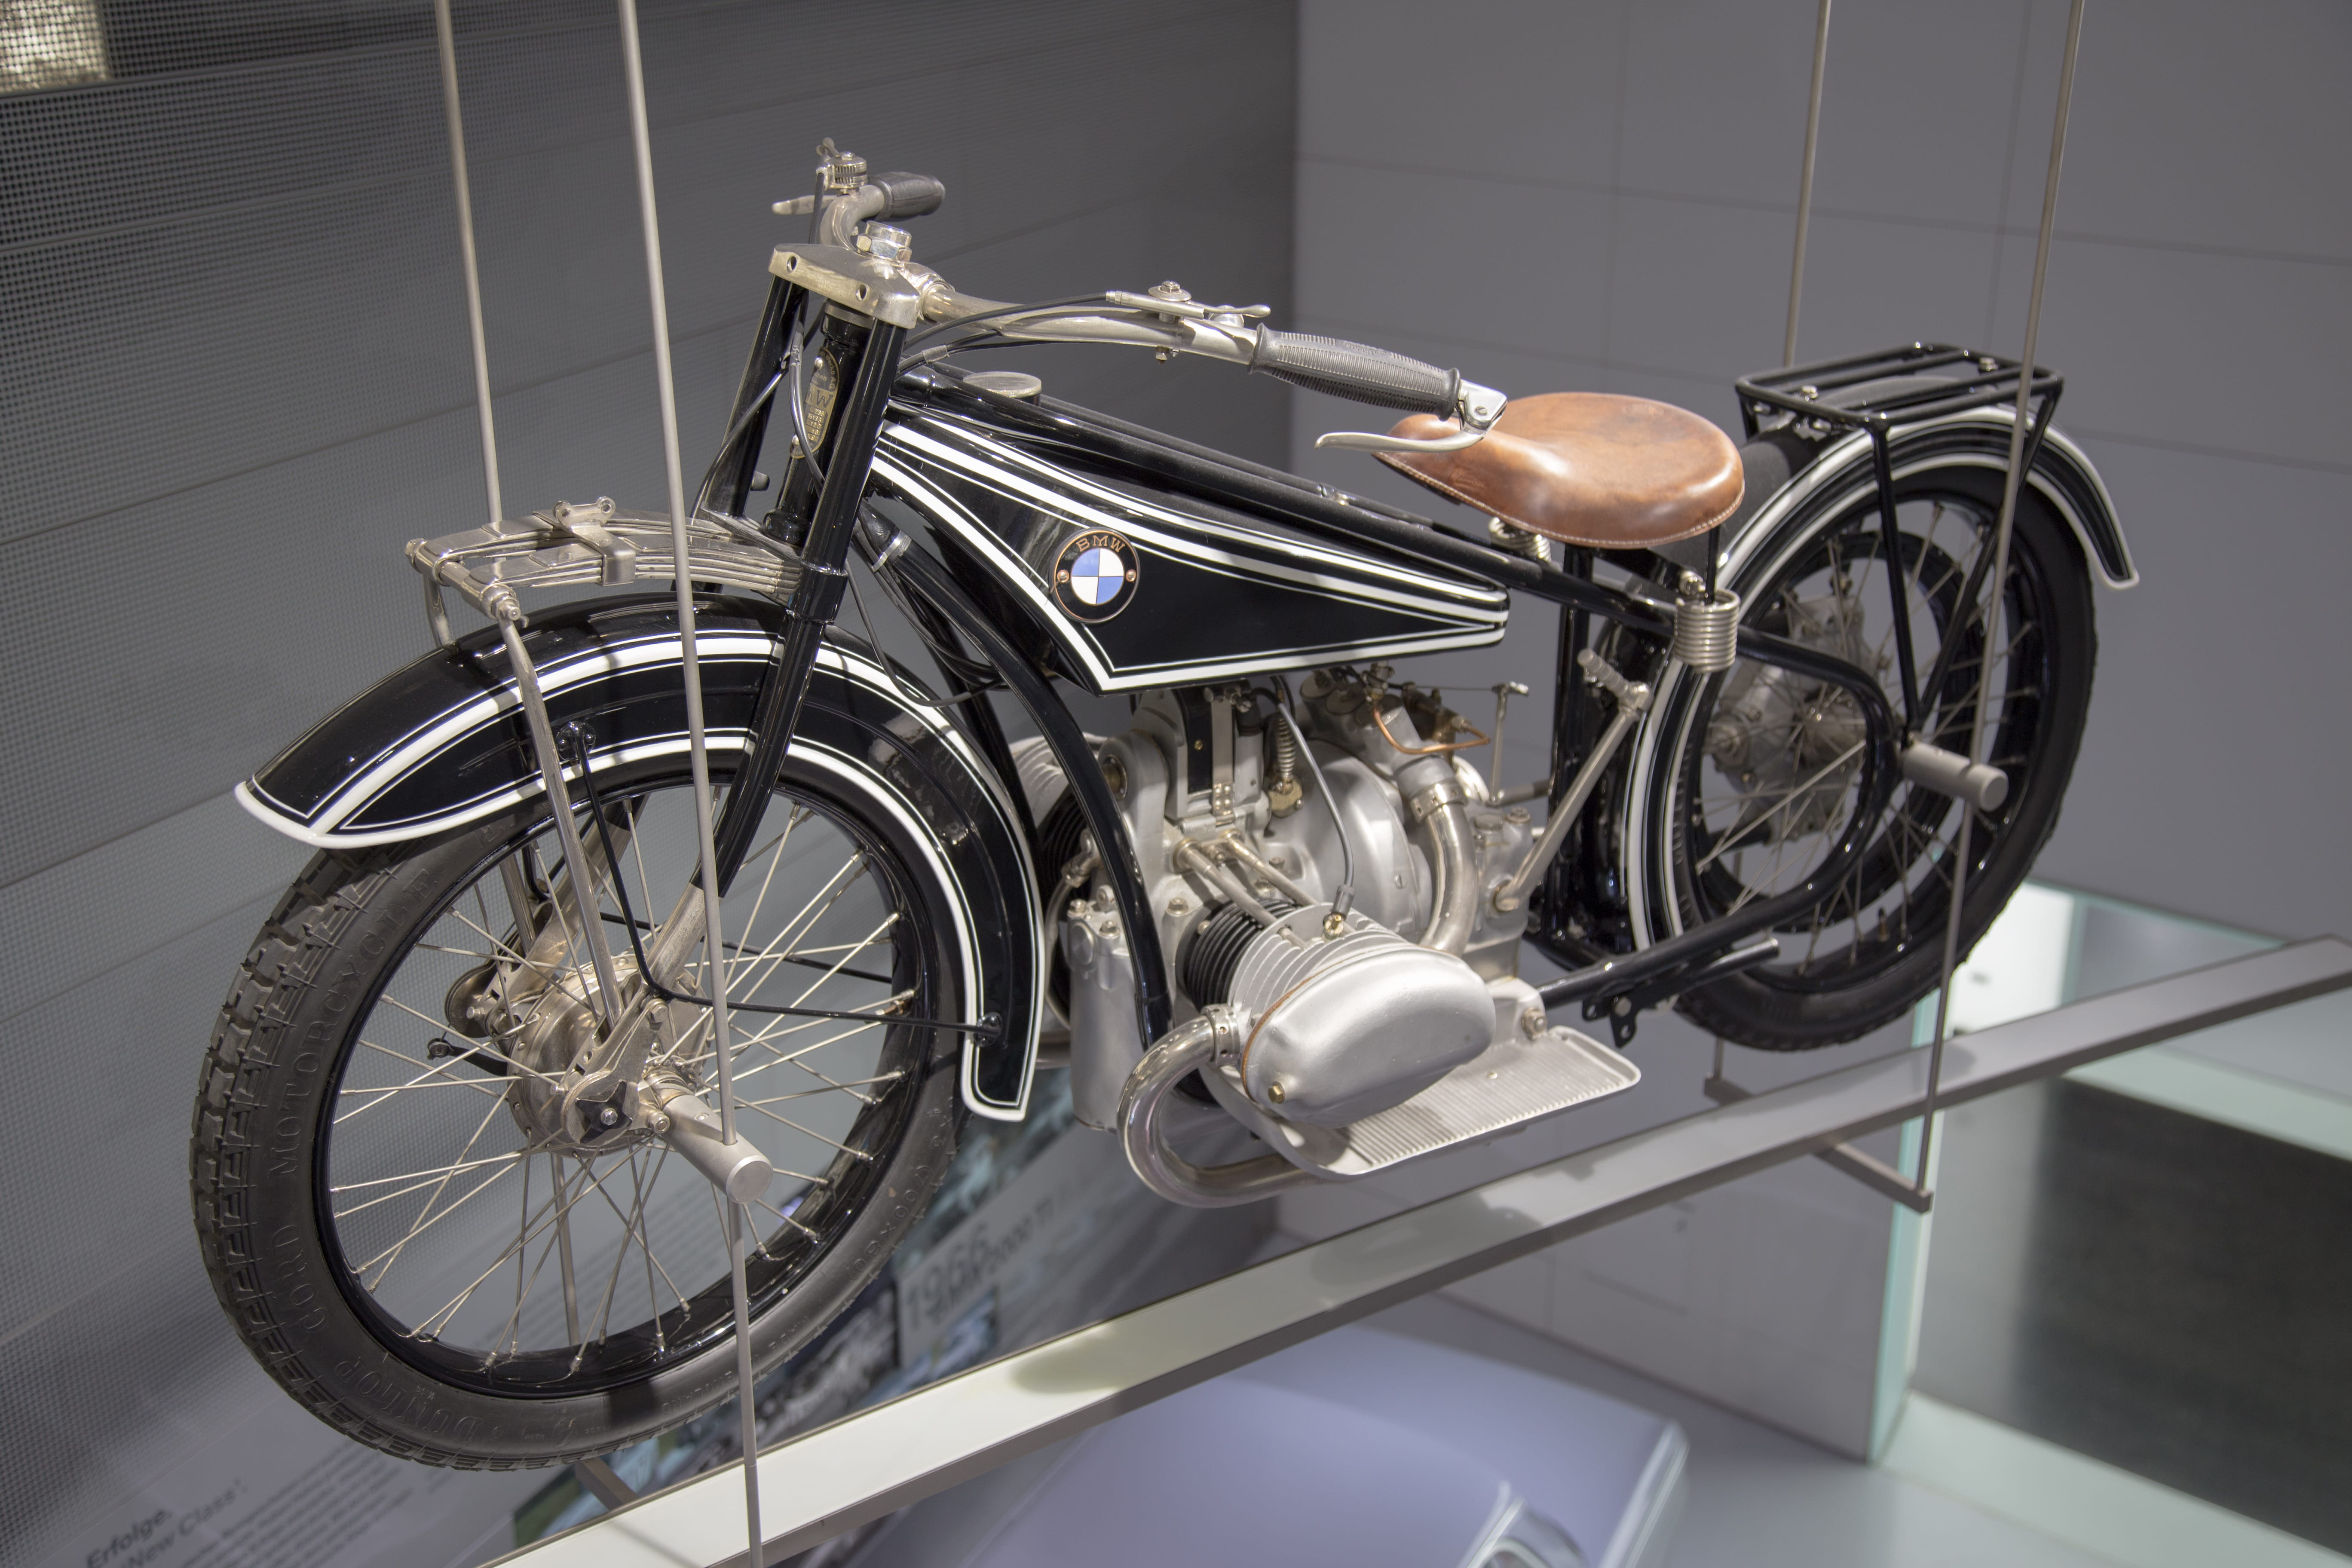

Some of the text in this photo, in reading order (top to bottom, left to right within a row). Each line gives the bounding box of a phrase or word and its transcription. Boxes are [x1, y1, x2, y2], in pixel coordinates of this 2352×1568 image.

[1076, 535, 1125, 552] BMW
[269, 867, 434, 1179] MOTORCYCLE
[272, 1225, 329, 1333] CORD
[334, 1355, 482, 1442] DUNLOP
[661, 1370, 734, 1415] ENGLAND
